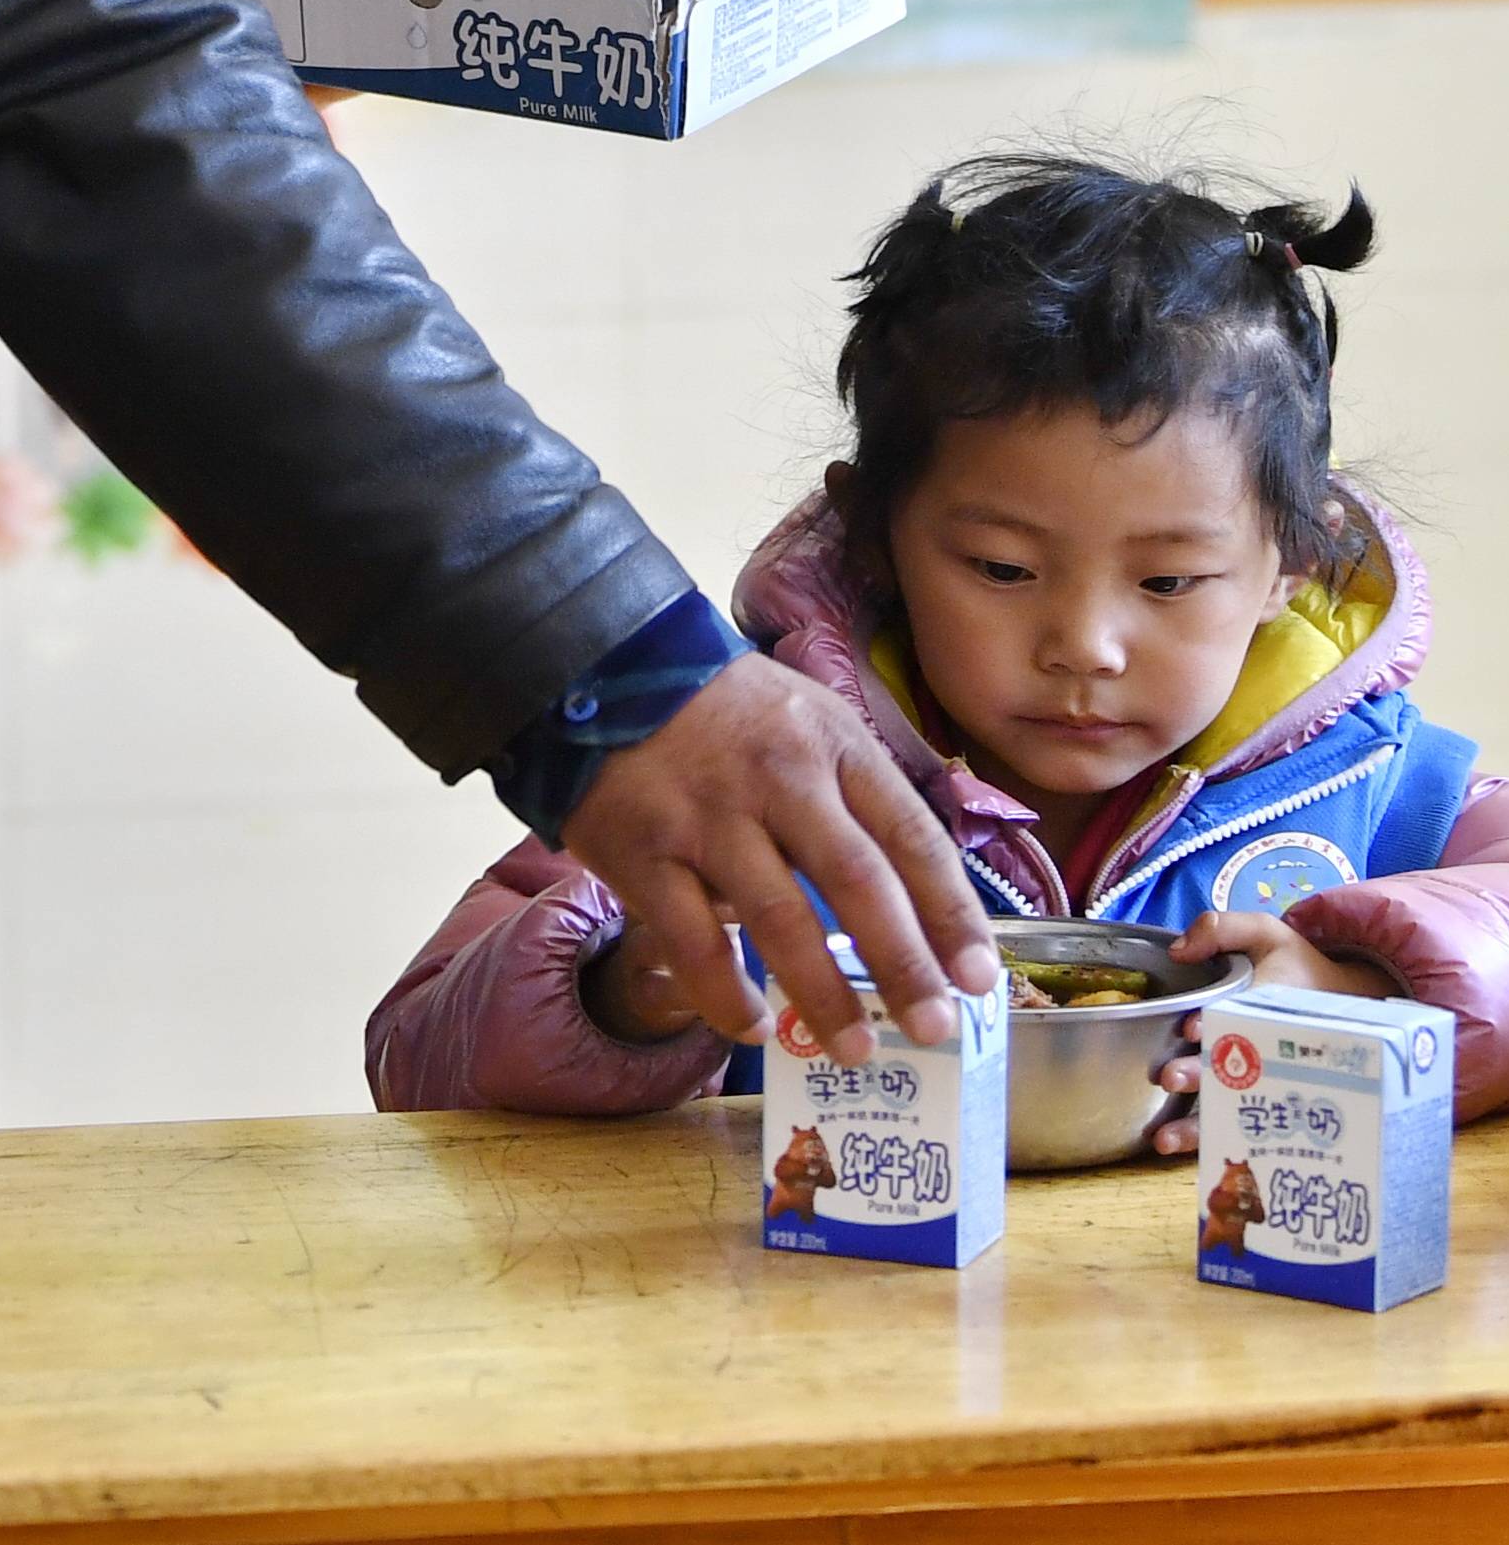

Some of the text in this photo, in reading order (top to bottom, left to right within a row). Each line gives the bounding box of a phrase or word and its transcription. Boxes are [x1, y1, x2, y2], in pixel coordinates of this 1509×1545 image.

[455, 10, 655, 111] 纯牛奶
[519, 96, 599, 124] Pure Milk
[840, 1131, 951, 1203] 纯牛奶
[867, 1199, 893, 1214] Pure
[1268, 1167, 1370, 1246] 纯牛奶
